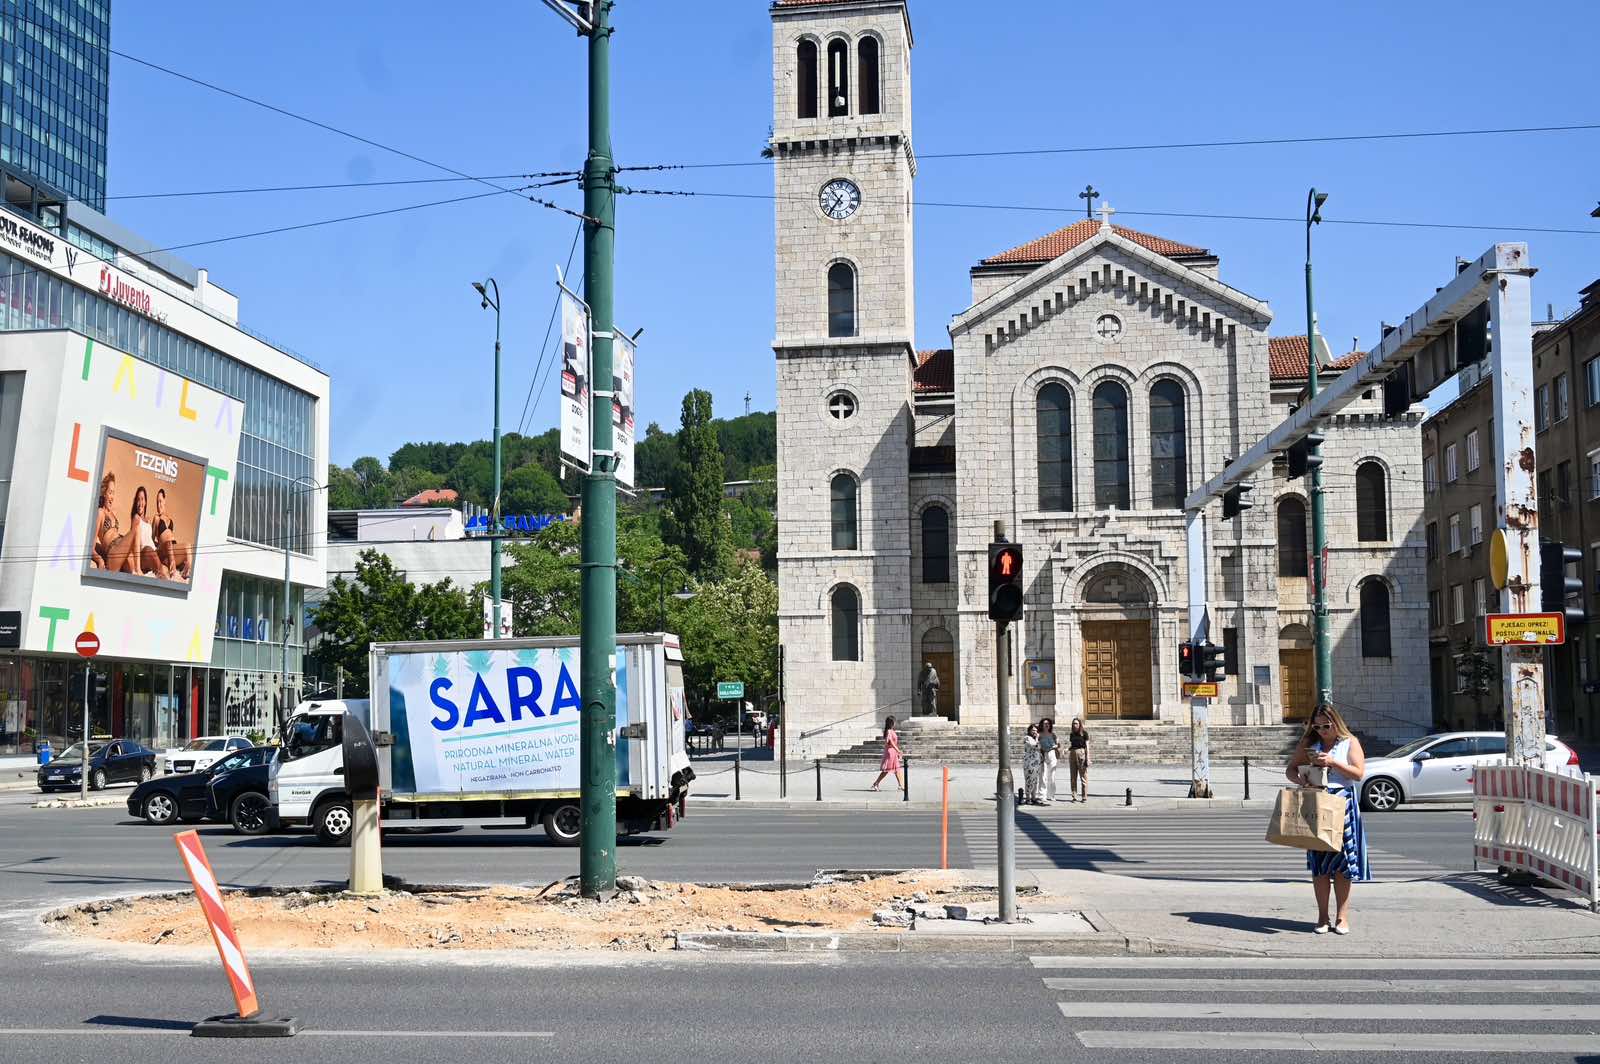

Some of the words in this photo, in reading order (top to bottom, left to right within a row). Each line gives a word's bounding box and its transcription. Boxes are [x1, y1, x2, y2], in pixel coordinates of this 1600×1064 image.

[19, 226, 54, 252] SEASONS
[113, 276, 151, 312] Juventa
[504, 513, 566, 530] BANK
[430, 661, 581, 731] SARA
[444, 746, 493, 761] PRIRODNA
[495, 737, 553, 754] MINERALNA
[555, 733, 580, 745] VODA
[453, 759, 497, 773] NATURAL
[499, 753, 544, 767] MINERAL
[545, 747, 575, 761] WATER
[470, 773, 507, 783] NEGAZIRANA
[525, 765, 562, 777] CARBONATED
